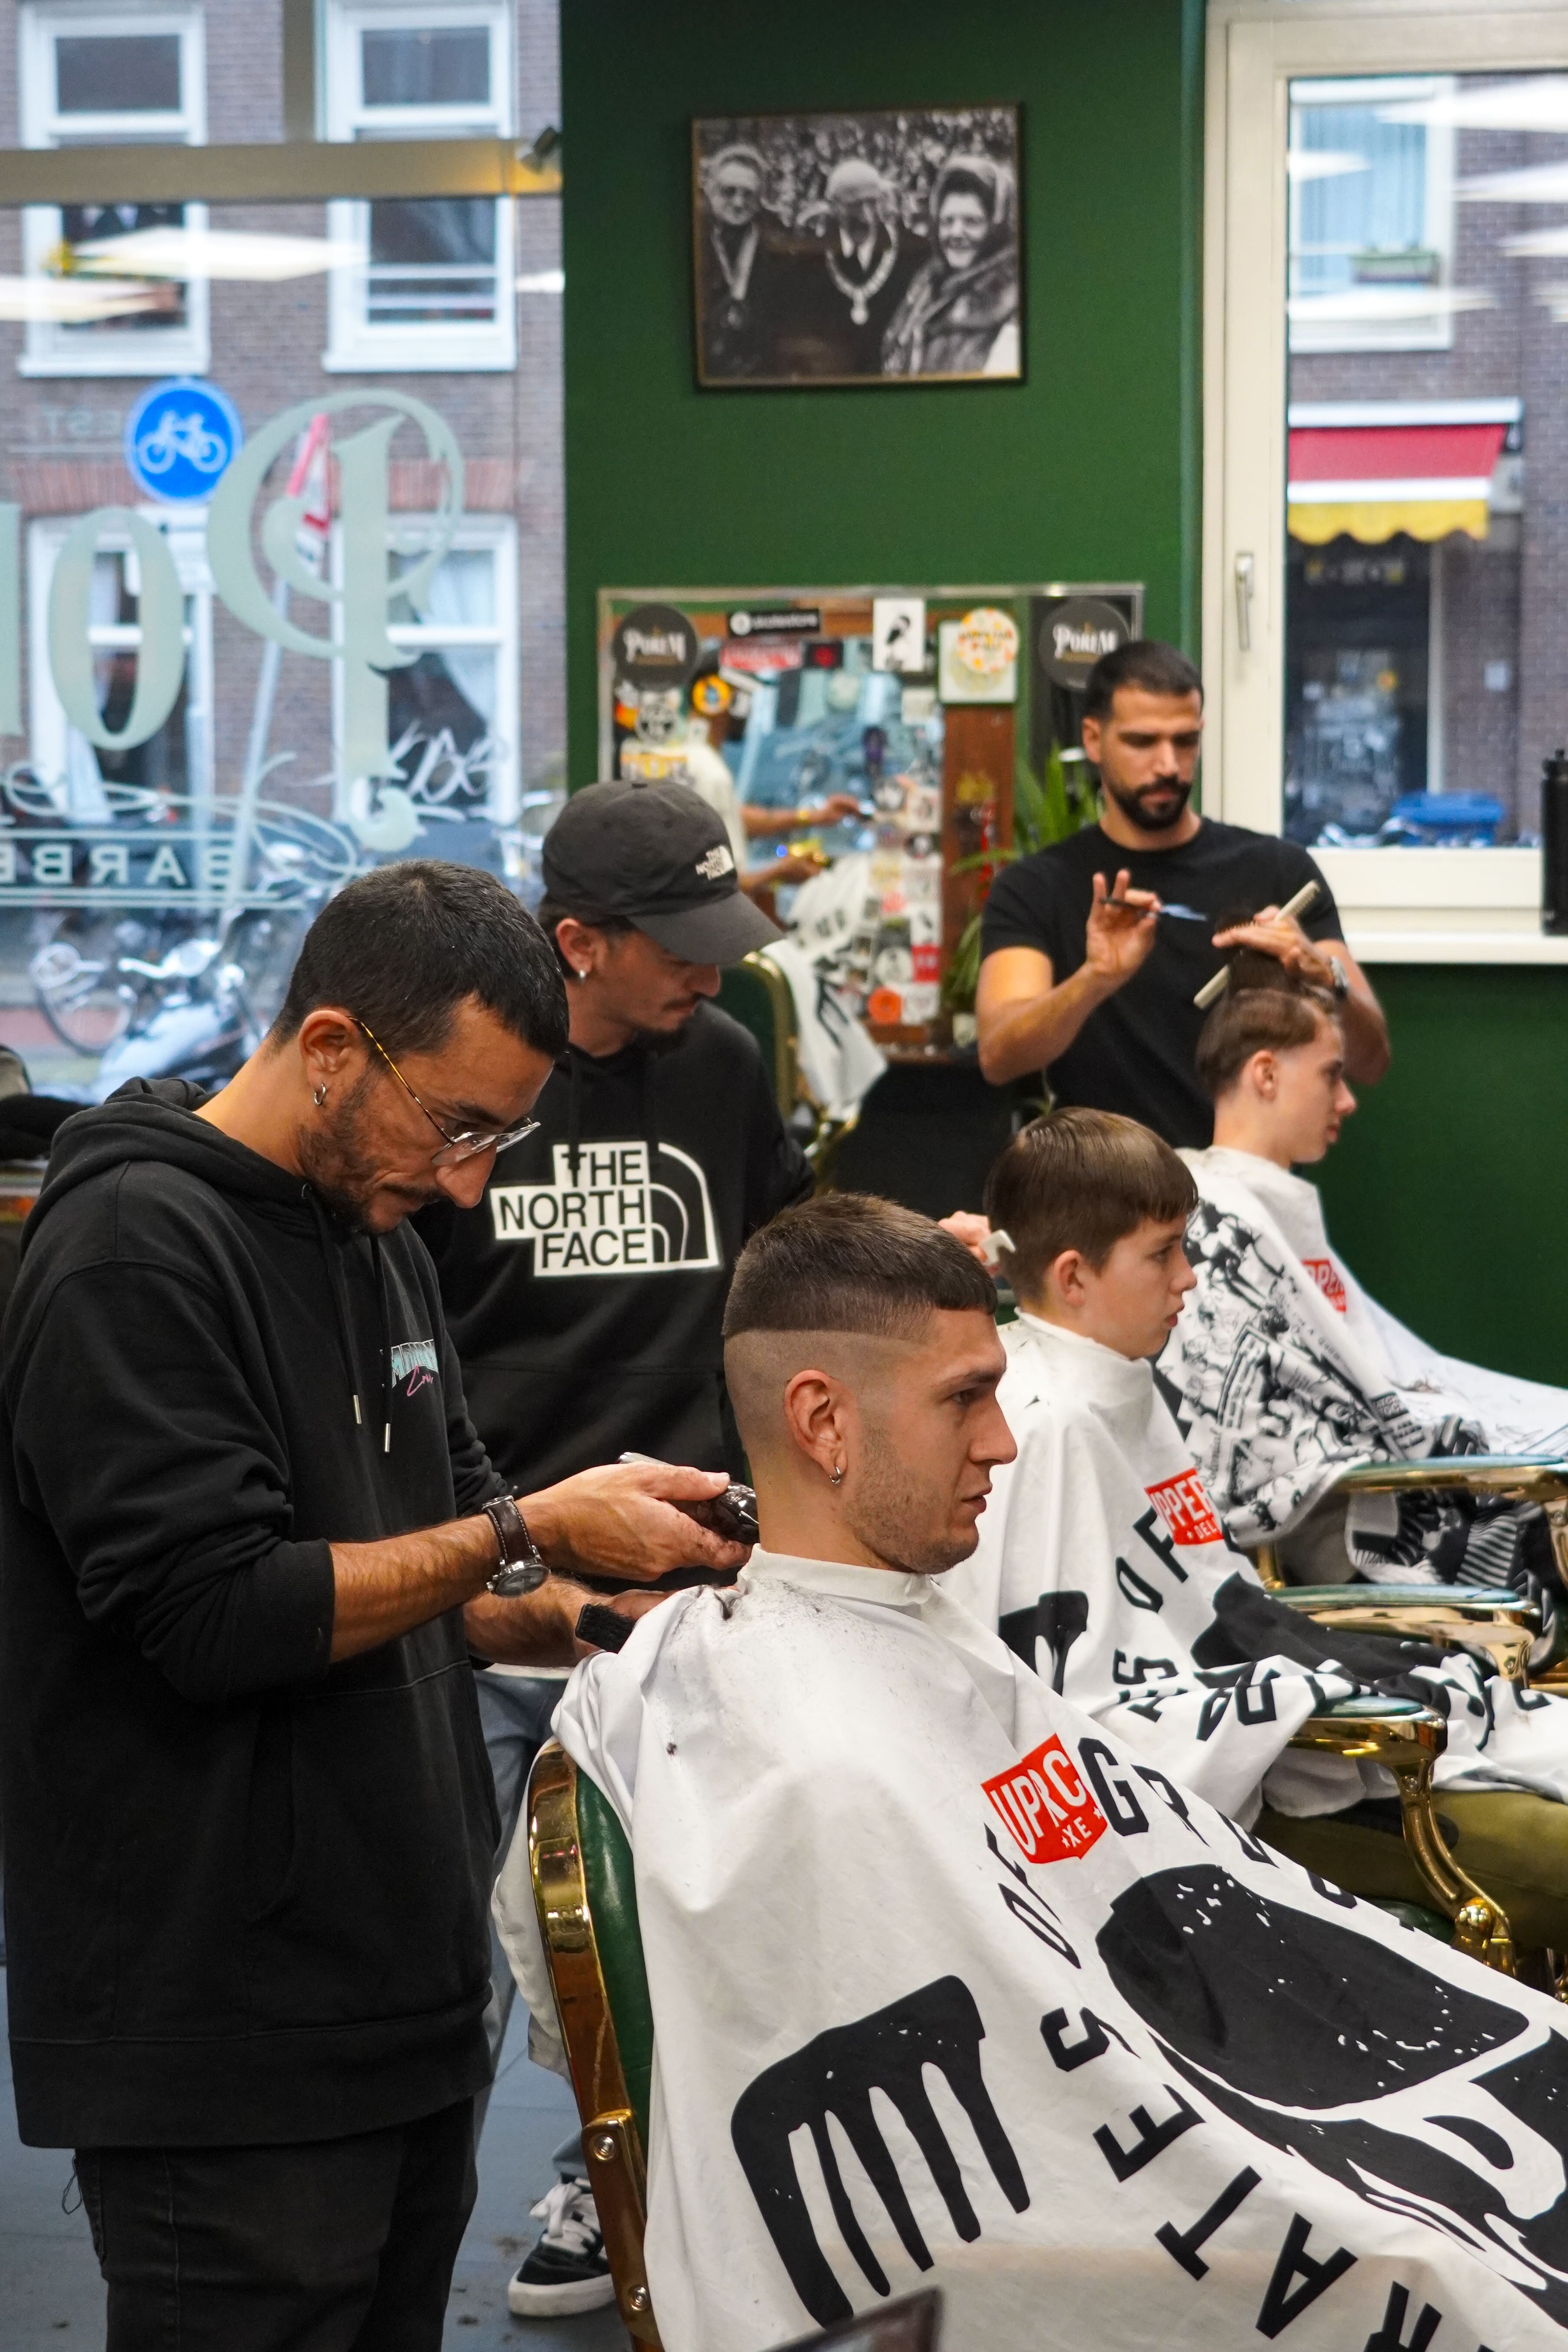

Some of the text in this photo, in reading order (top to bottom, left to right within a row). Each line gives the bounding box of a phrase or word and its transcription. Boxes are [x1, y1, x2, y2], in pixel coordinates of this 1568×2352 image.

[561, 1149, 644, 1187] THE
[499, 1188, 645, 1230] NORTH
[541, 1229, 647, 1268] FACE
[1040, 2007, 1496, 2352] RATES
